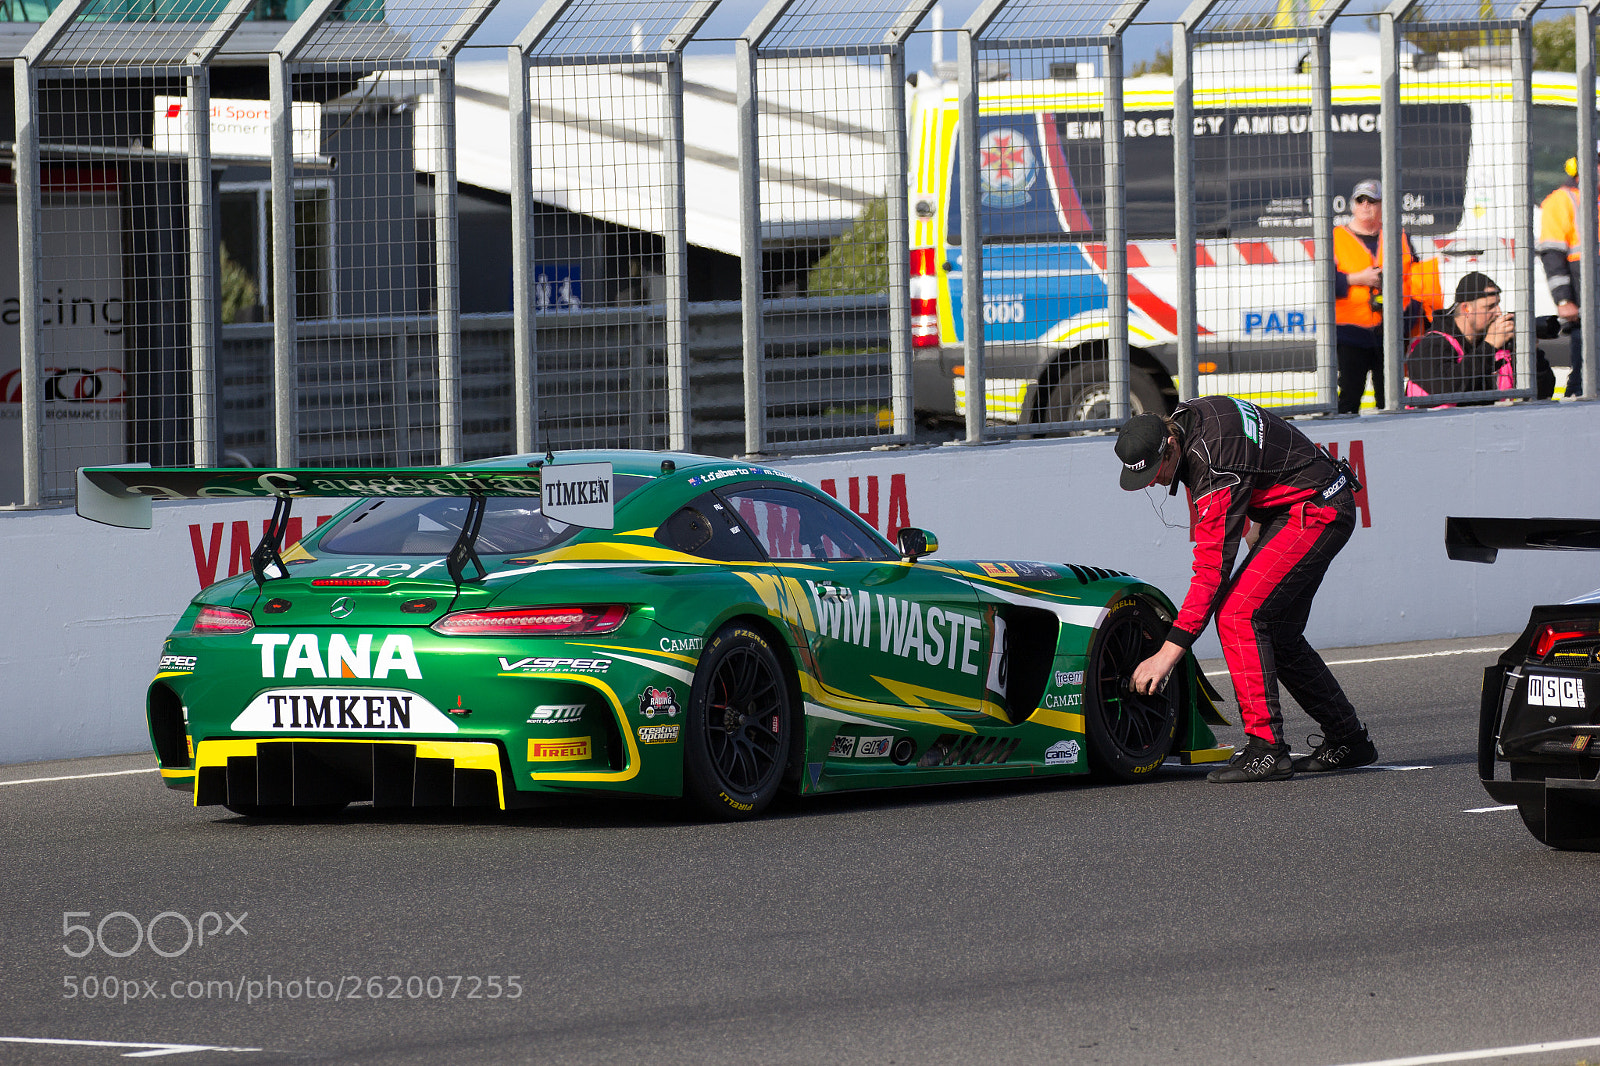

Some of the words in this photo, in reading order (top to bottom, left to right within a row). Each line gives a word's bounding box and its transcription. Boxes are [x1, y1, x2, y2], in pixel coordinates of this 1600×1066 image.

[226, 106, 270, 121] Sport
[1066, 116, 1225, 140] EMRGECY
[1233, 112, 1381, 136] AMBUANC
[545, 480, 610, 507] TIMKEN
[1322, 475, 1346, 499] sparco
[876, 593, 982, 676] WASTE
[160, 655, 198, 666] SPEC
[251, 633, 424, 680] TANA
[267, 695, 413, 729] TIMKEN
[533, 741, 588, 757] PIRELLI
[1045, 750, 1073, 760] cams
